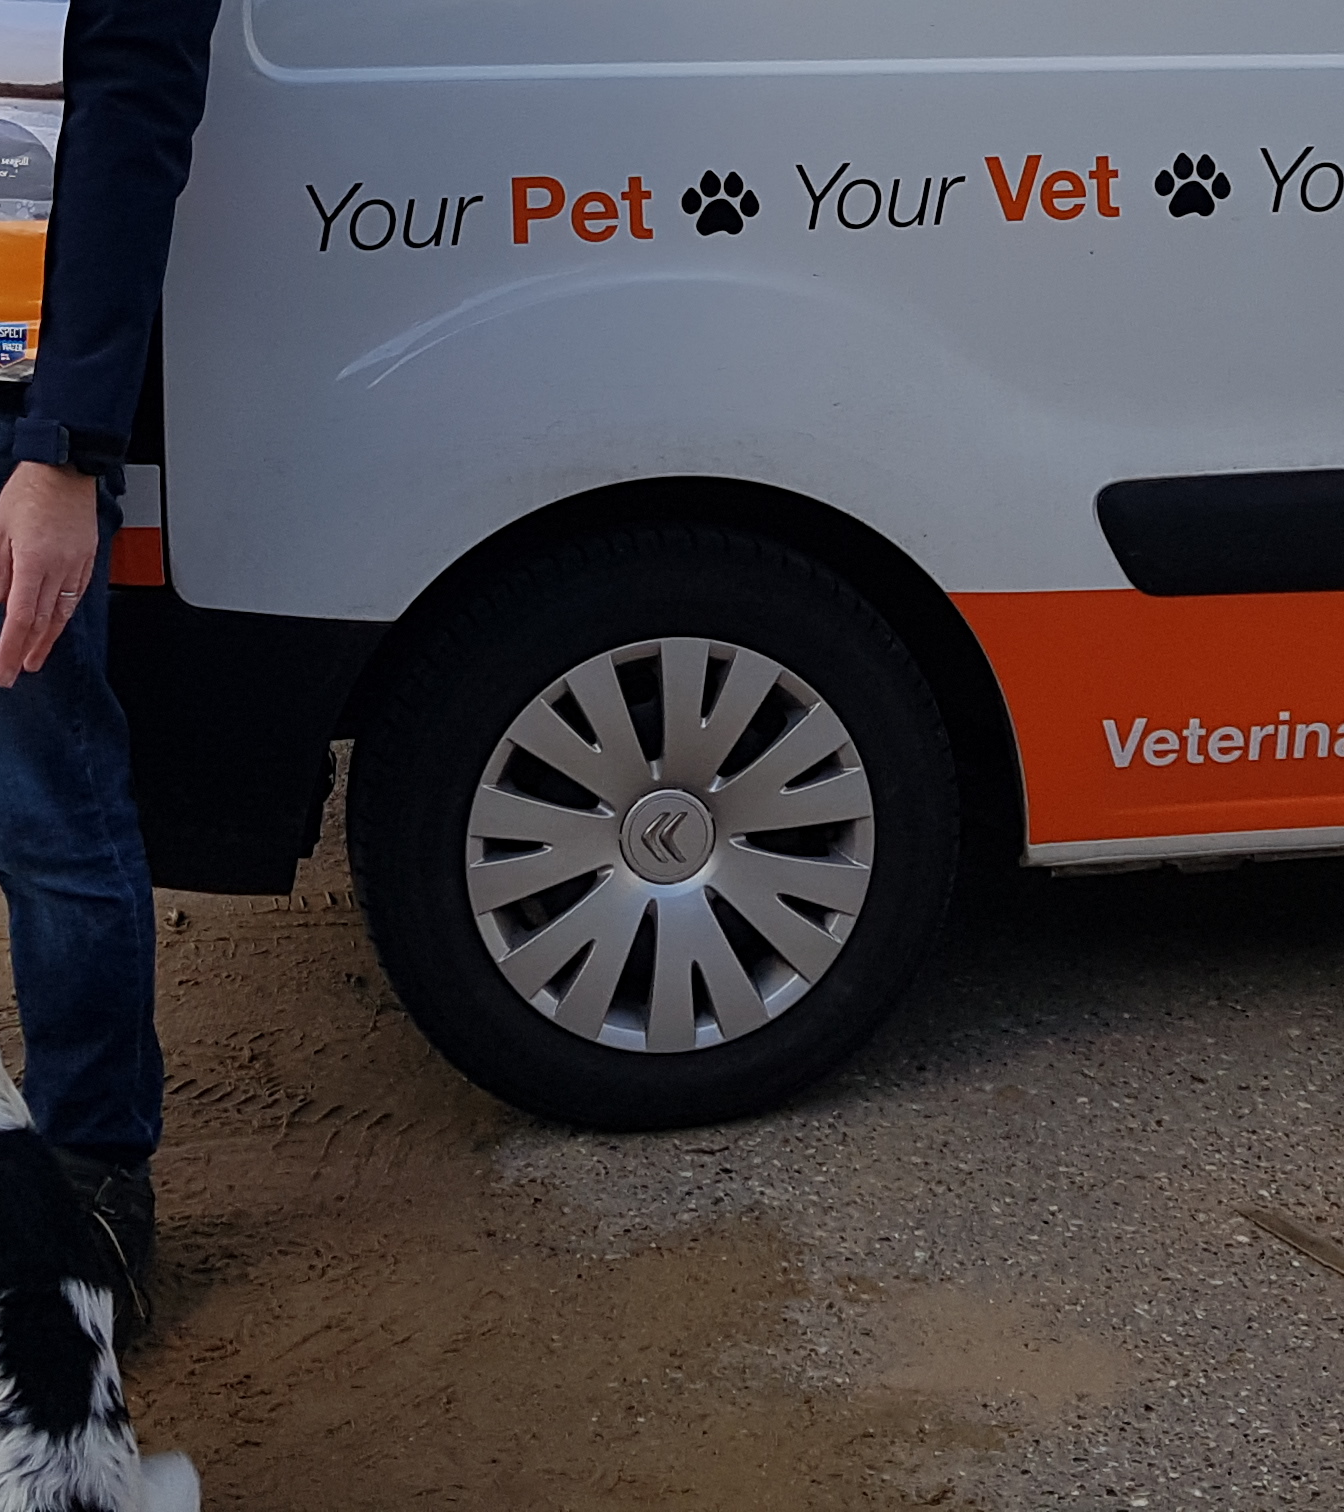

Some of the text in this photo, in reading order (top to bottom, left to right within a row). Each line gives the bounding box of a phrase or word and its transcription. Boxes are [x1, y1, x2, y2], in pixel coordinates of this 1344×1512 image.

[309, 178, 483, 252] Your
[511, 177, 653, 245] Pet
[796, 162, 965, 231] Your
[985, 154, 1120, 222] Vet
